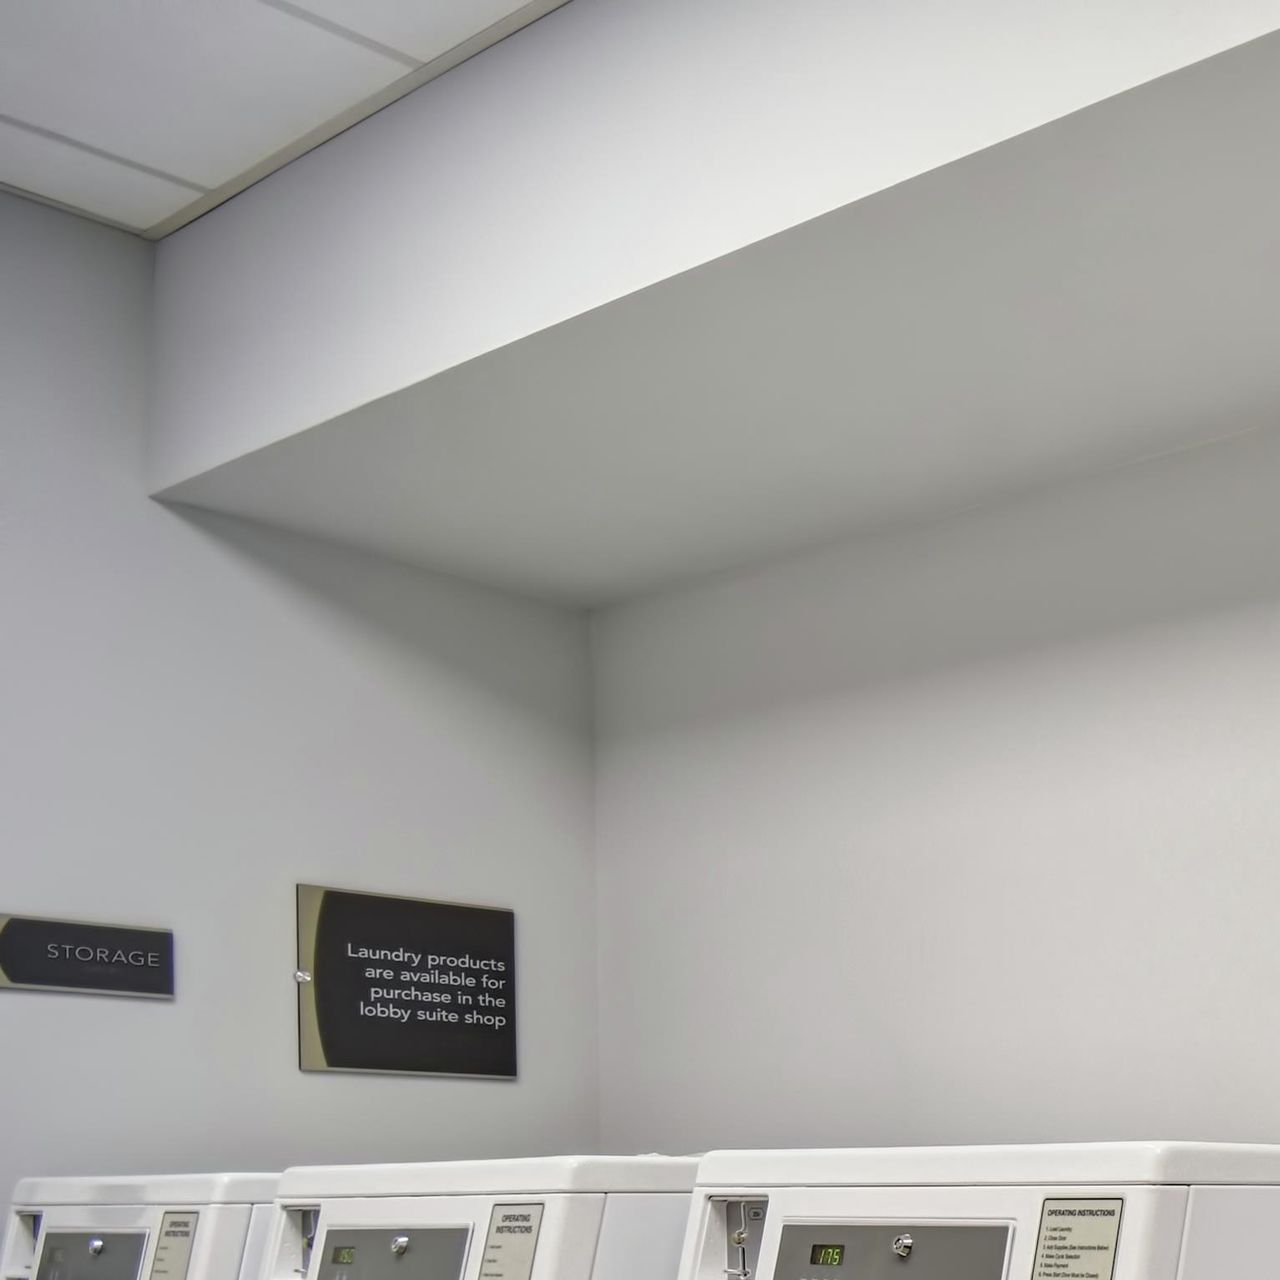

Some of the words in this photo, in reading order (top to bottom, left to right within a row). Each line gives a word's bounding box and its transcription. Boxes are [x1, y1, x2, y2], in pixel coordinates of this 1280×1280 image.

[47, 943, 160, 967] STORAGE
[348, 943, 421, 966] Laundry
[428, 954, 505, 971] products
[365, 968, 394, 979] are
[400, 970, 476, 986] available
[481, 974, 505, 989] for
[370, 986, 451, 1003] purchase
[457, 991, 472, 1004] in
[477, 993, 505, 1007] the
[360, 1001, 411, 1022] lobby
[417, 1008, 458, 1022] suite
[464, 1010, 506, 1029] shop
[819, 1249, 840, 1265] 175
